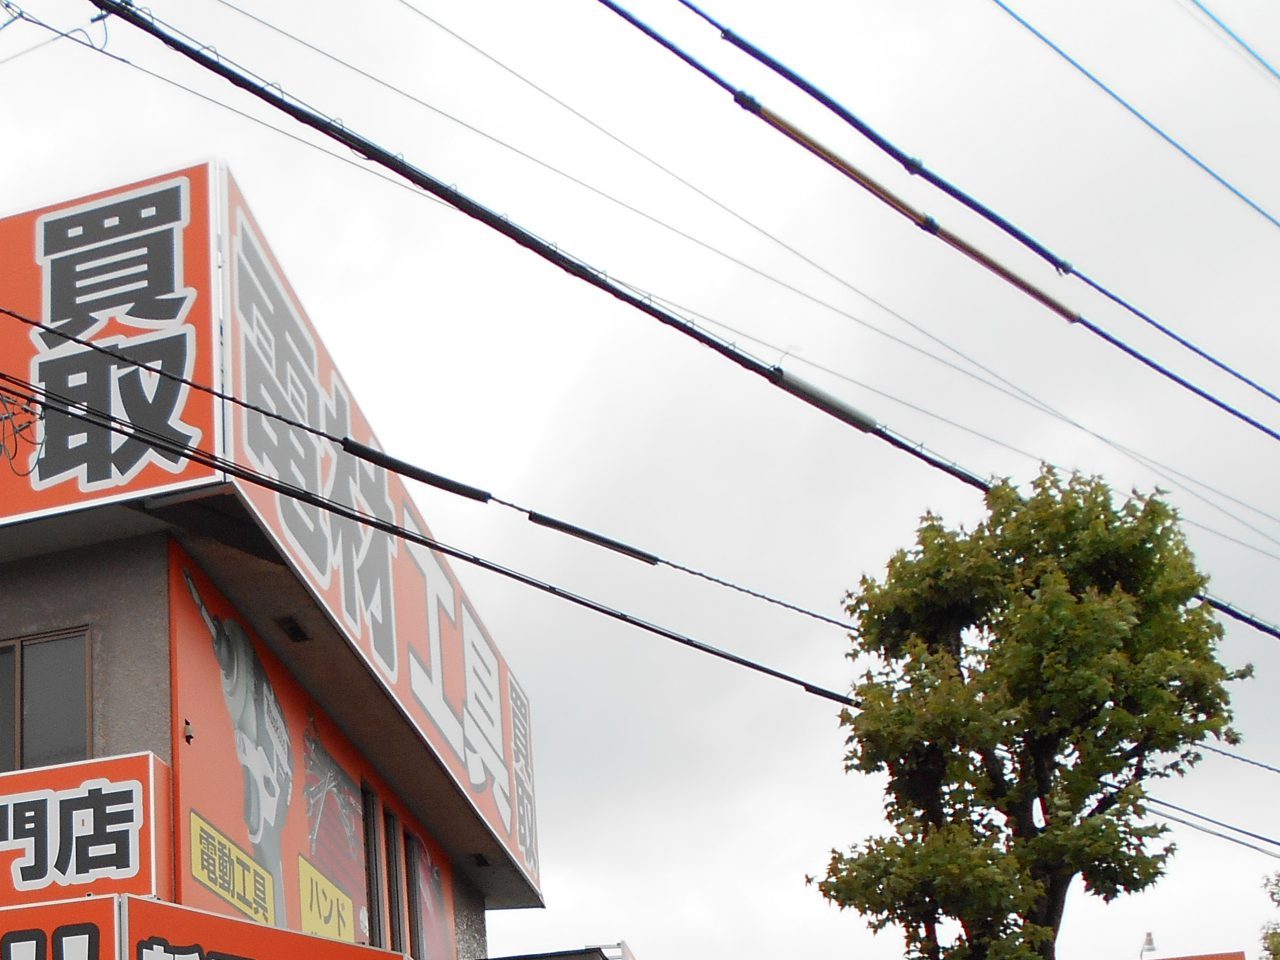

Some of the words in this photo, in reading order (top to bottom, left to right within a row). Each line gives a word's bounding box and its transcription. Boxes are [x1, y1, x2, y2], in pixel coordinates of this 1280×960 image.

[30, 176, 202, 491] 買取
[199, 825, 269, 922] 電動工具
[309, 877, 347, 936] ハンド
